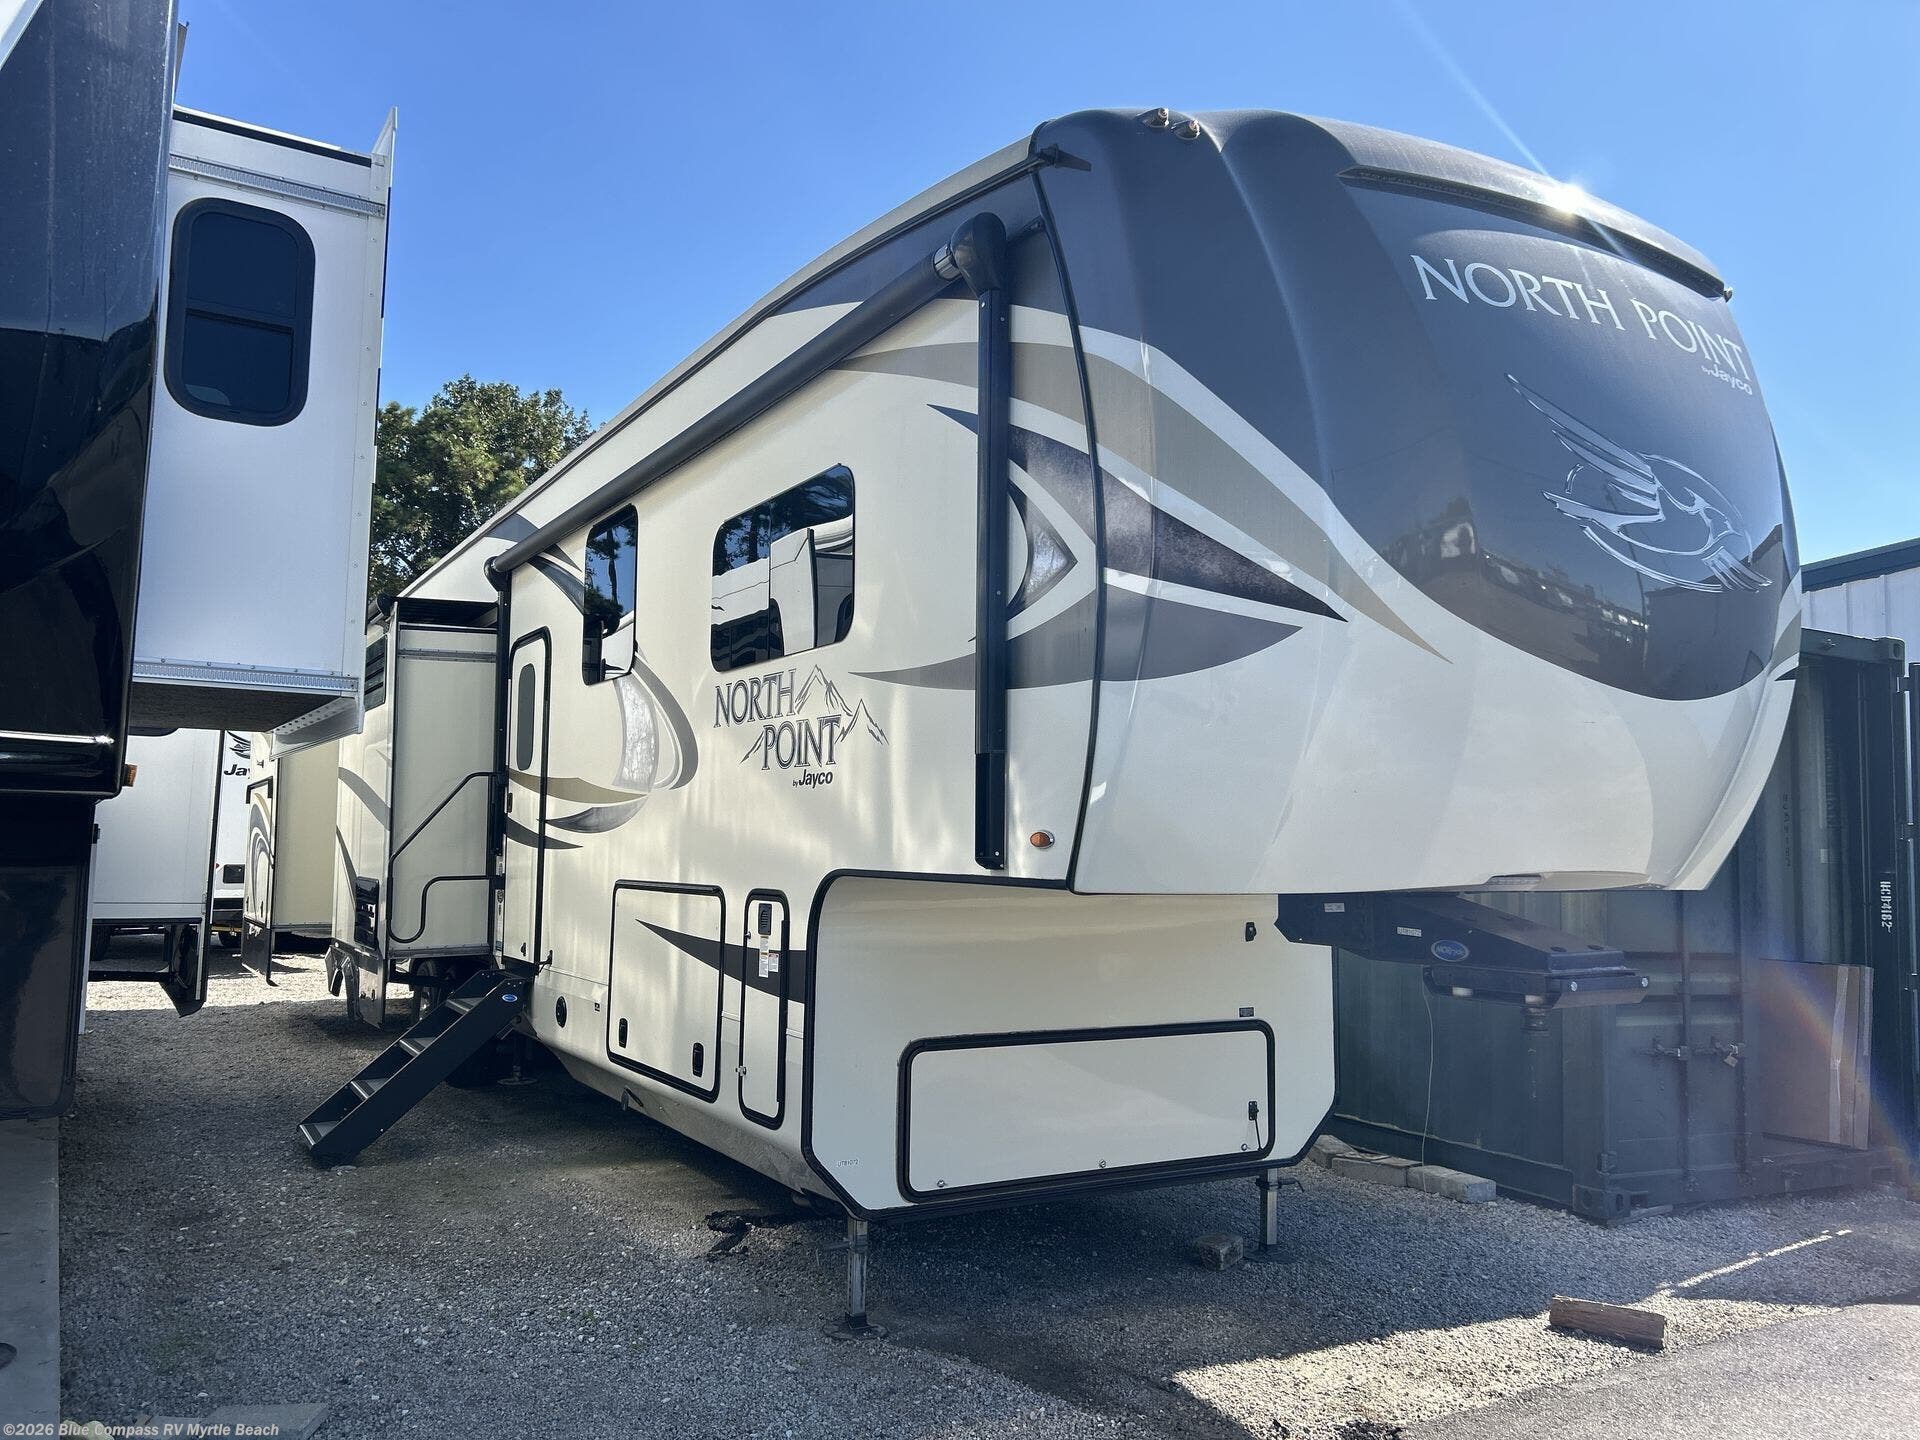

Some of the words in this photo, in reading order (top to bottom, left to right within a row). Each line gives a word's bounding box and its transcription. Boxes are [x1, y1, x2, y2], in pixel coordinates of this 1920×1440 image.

[1411, 255, 1626, 331] NORTH
[1630, 297, 1751, 382] POINT
[1709, 363, 1753, 396] Jayco
[713, 668, 797, 729] NORTH
[761, 714, 843, 771] POINT
[799, 768, 834, 789] Jayco
